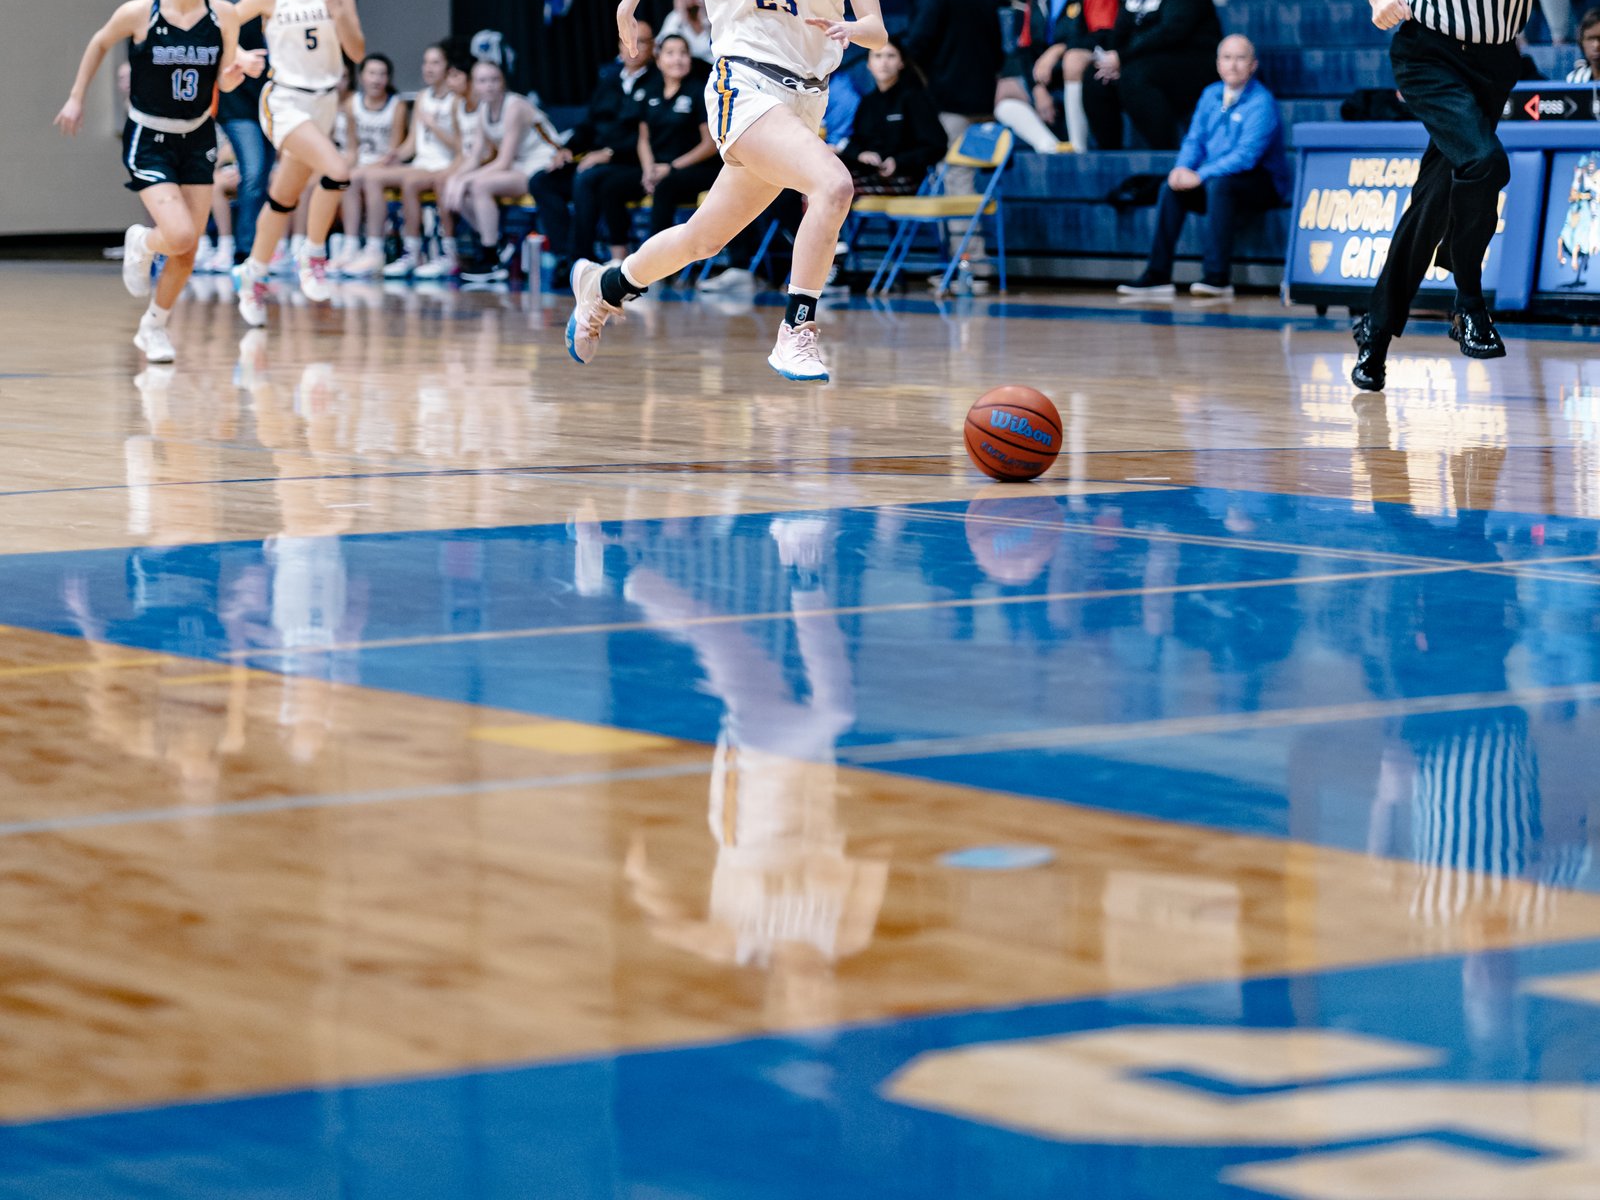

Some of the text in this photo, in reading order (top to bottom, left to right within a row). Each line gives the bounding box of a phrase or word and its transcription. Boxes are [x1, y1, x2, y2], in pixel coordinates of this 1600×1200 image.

[304, 27, 318, 50] 5
[152, 45, 220, 66] ROSARY
[171, 68, 199, 101] 13
[1348, 157, 1421, 188] WELCOM
[1299, 188, 1398, 234] AURORA
[990, 409, 1053, 447] Wilson
